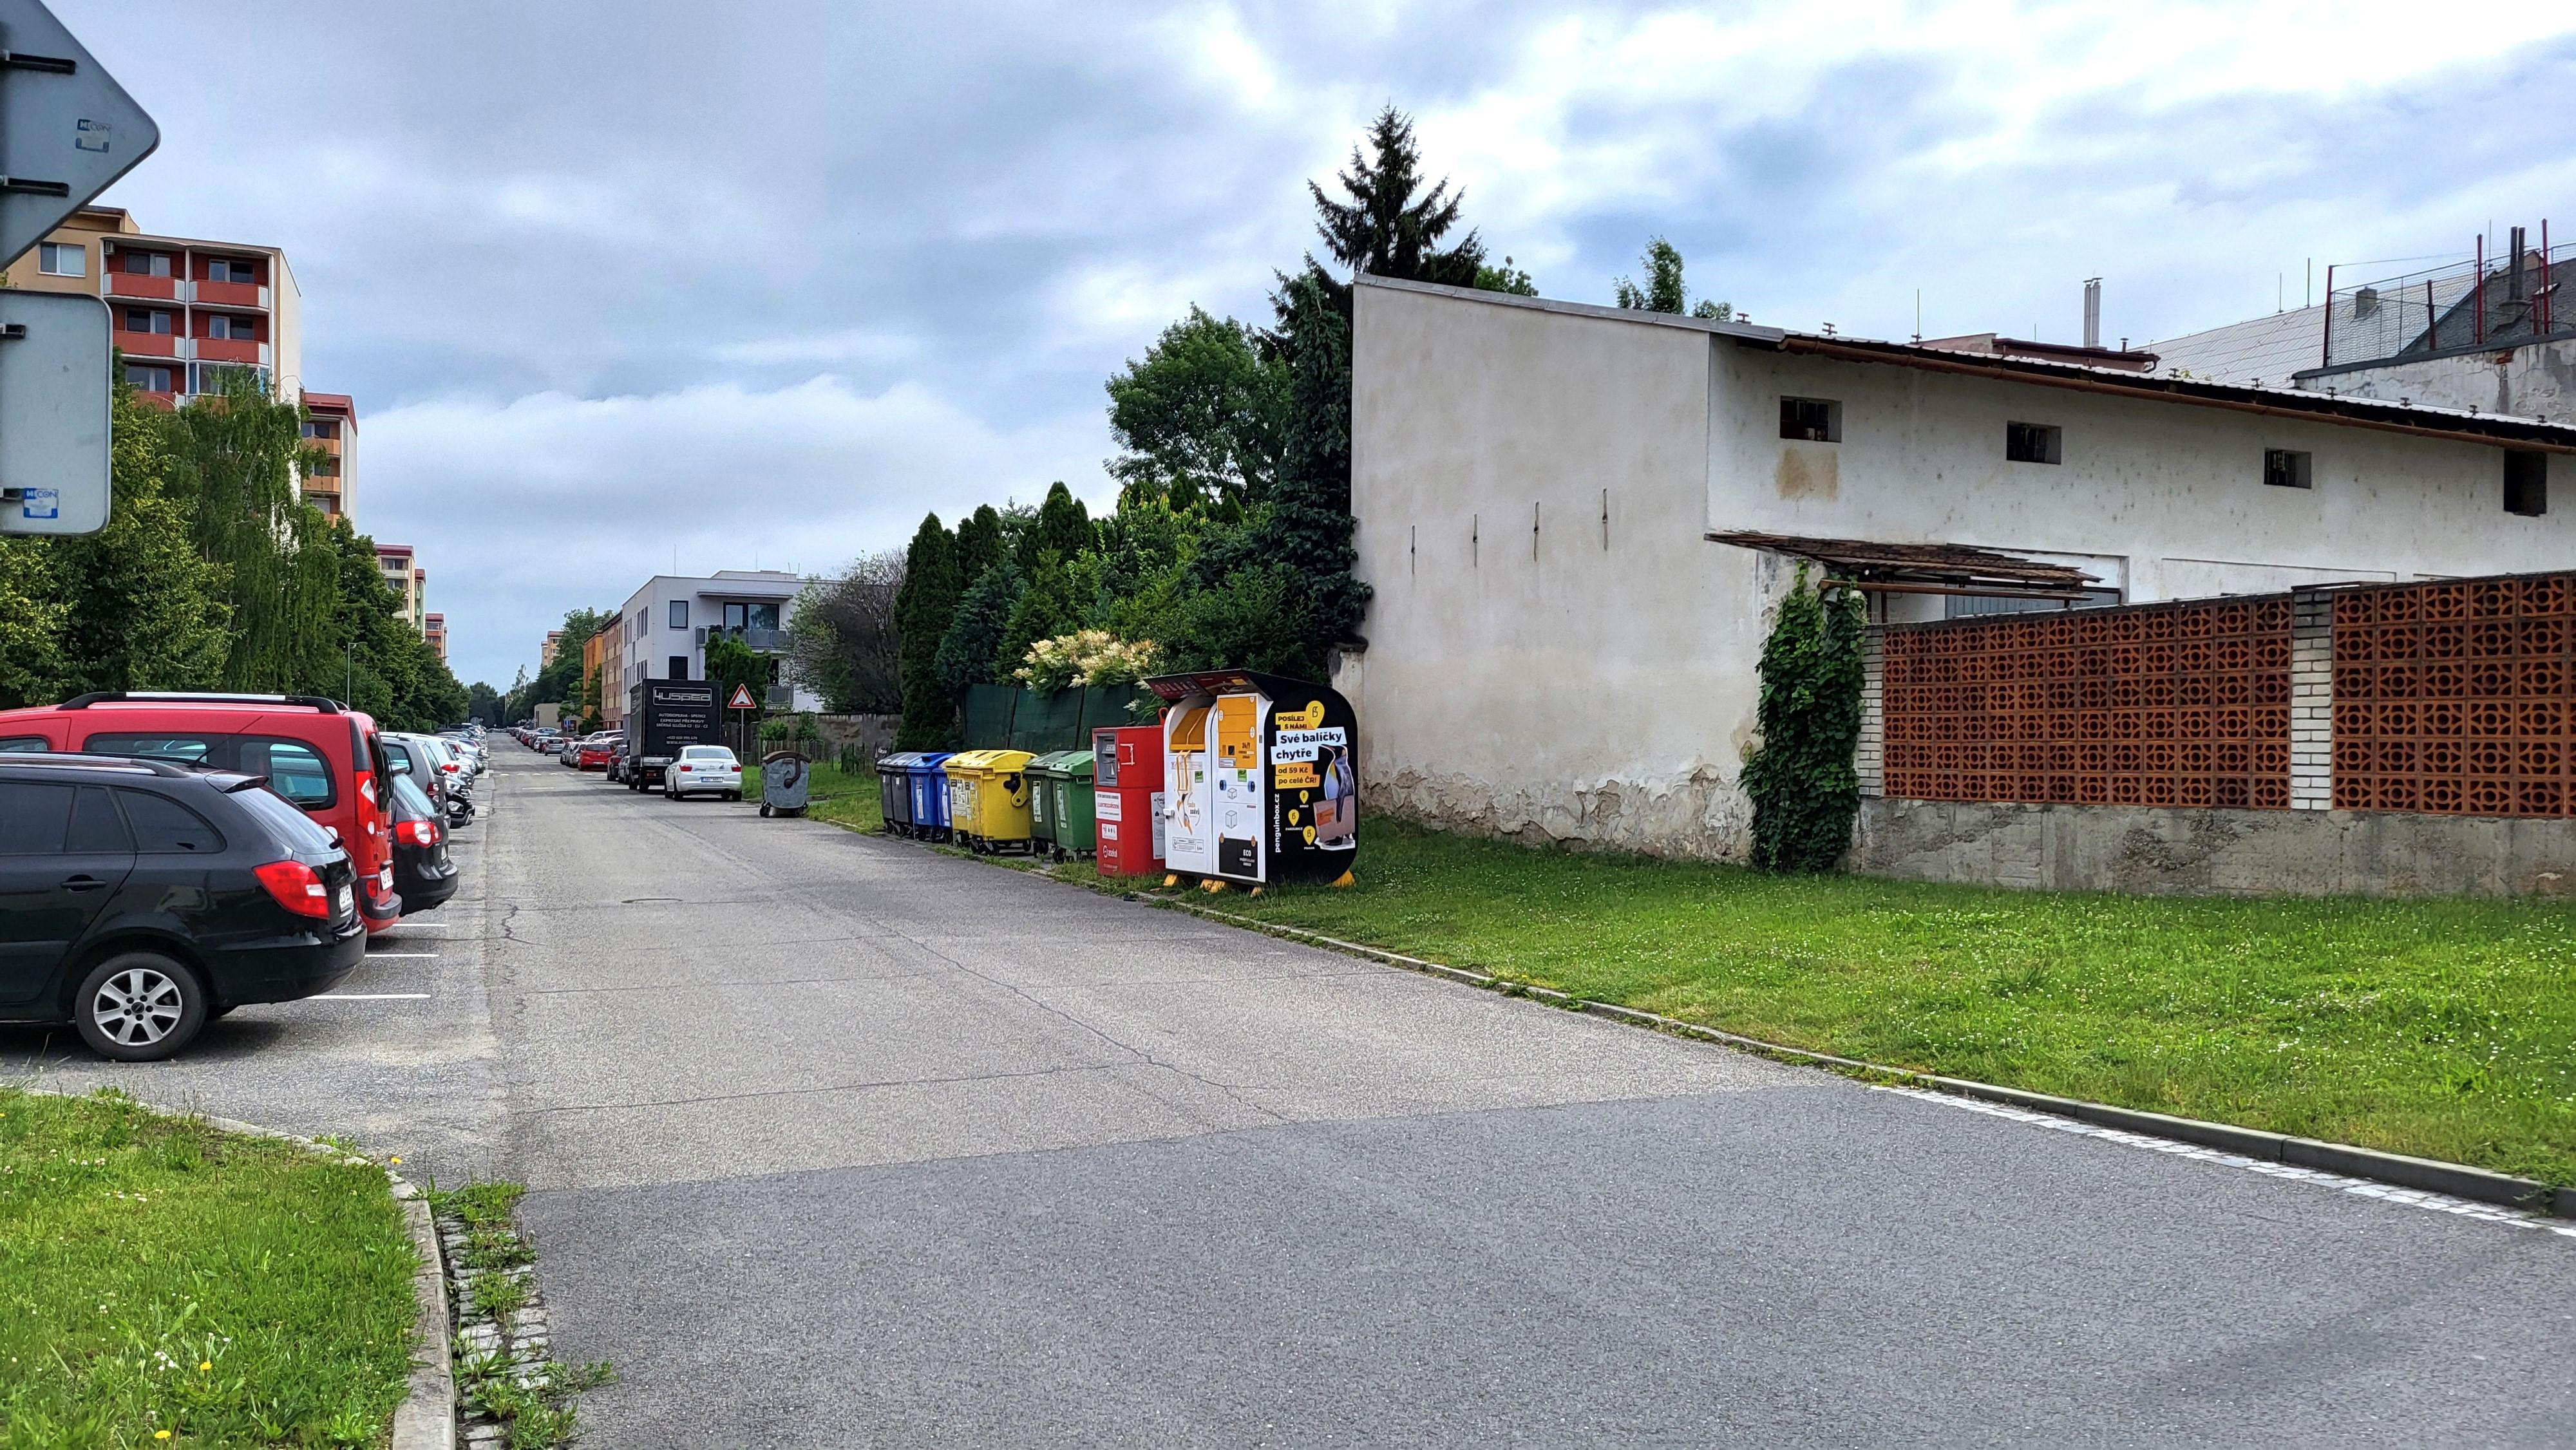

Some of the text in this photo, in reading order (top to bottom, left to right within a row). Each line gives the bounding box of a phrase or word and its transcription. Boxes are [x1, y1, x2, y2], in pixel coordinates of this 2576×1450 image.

[1280, 731, 1342, 744] Své balíčky
[1276, 748, 1312, 760] chytře
